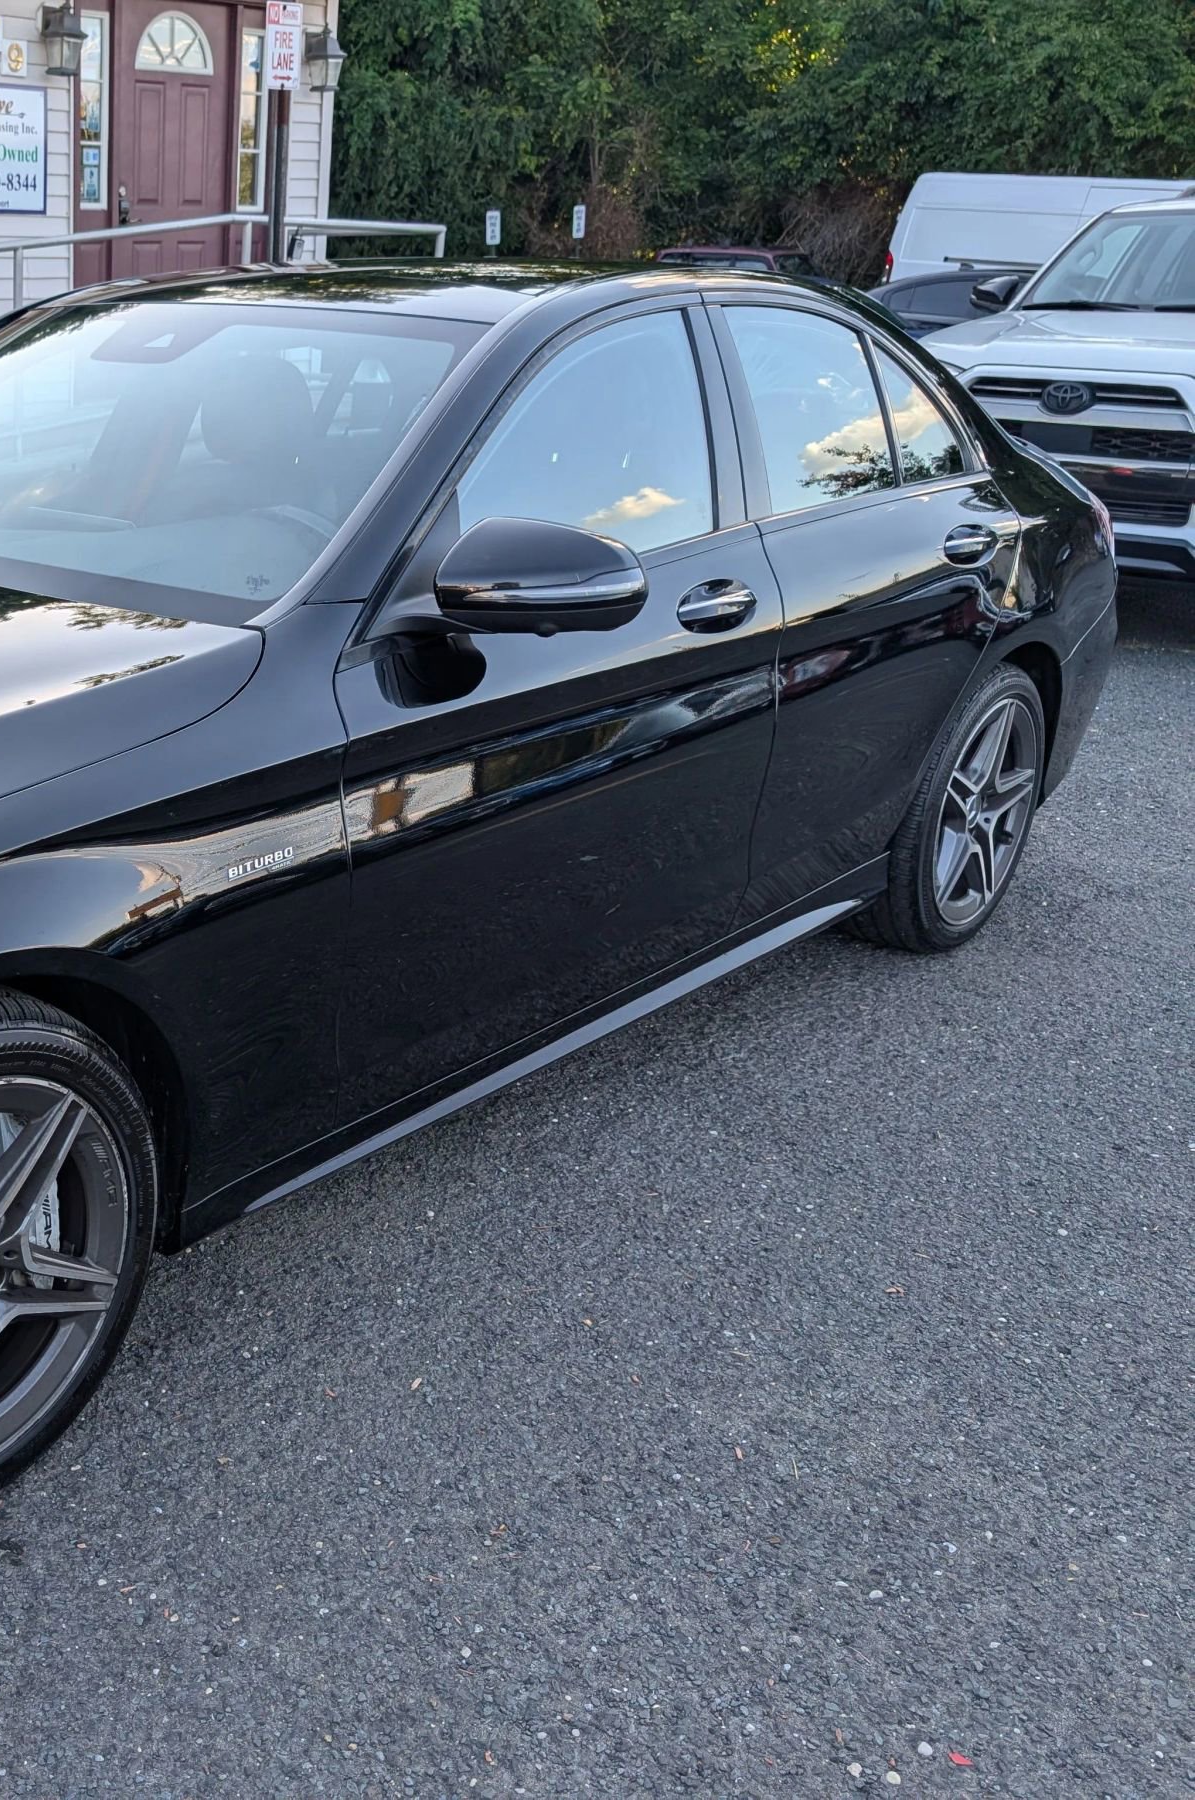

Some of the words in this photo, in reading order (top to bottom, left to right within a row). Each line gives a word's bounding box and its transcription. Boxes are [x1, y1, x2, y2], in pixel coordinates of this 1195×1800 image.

[269, 5, 279, 22] NO
[274, 31, 294, 49] FIRE
[271, 52, 294, 71] LANE
[21, 122, 38, 135] Inc.
[228, 846, 293, 879] BITURBO
